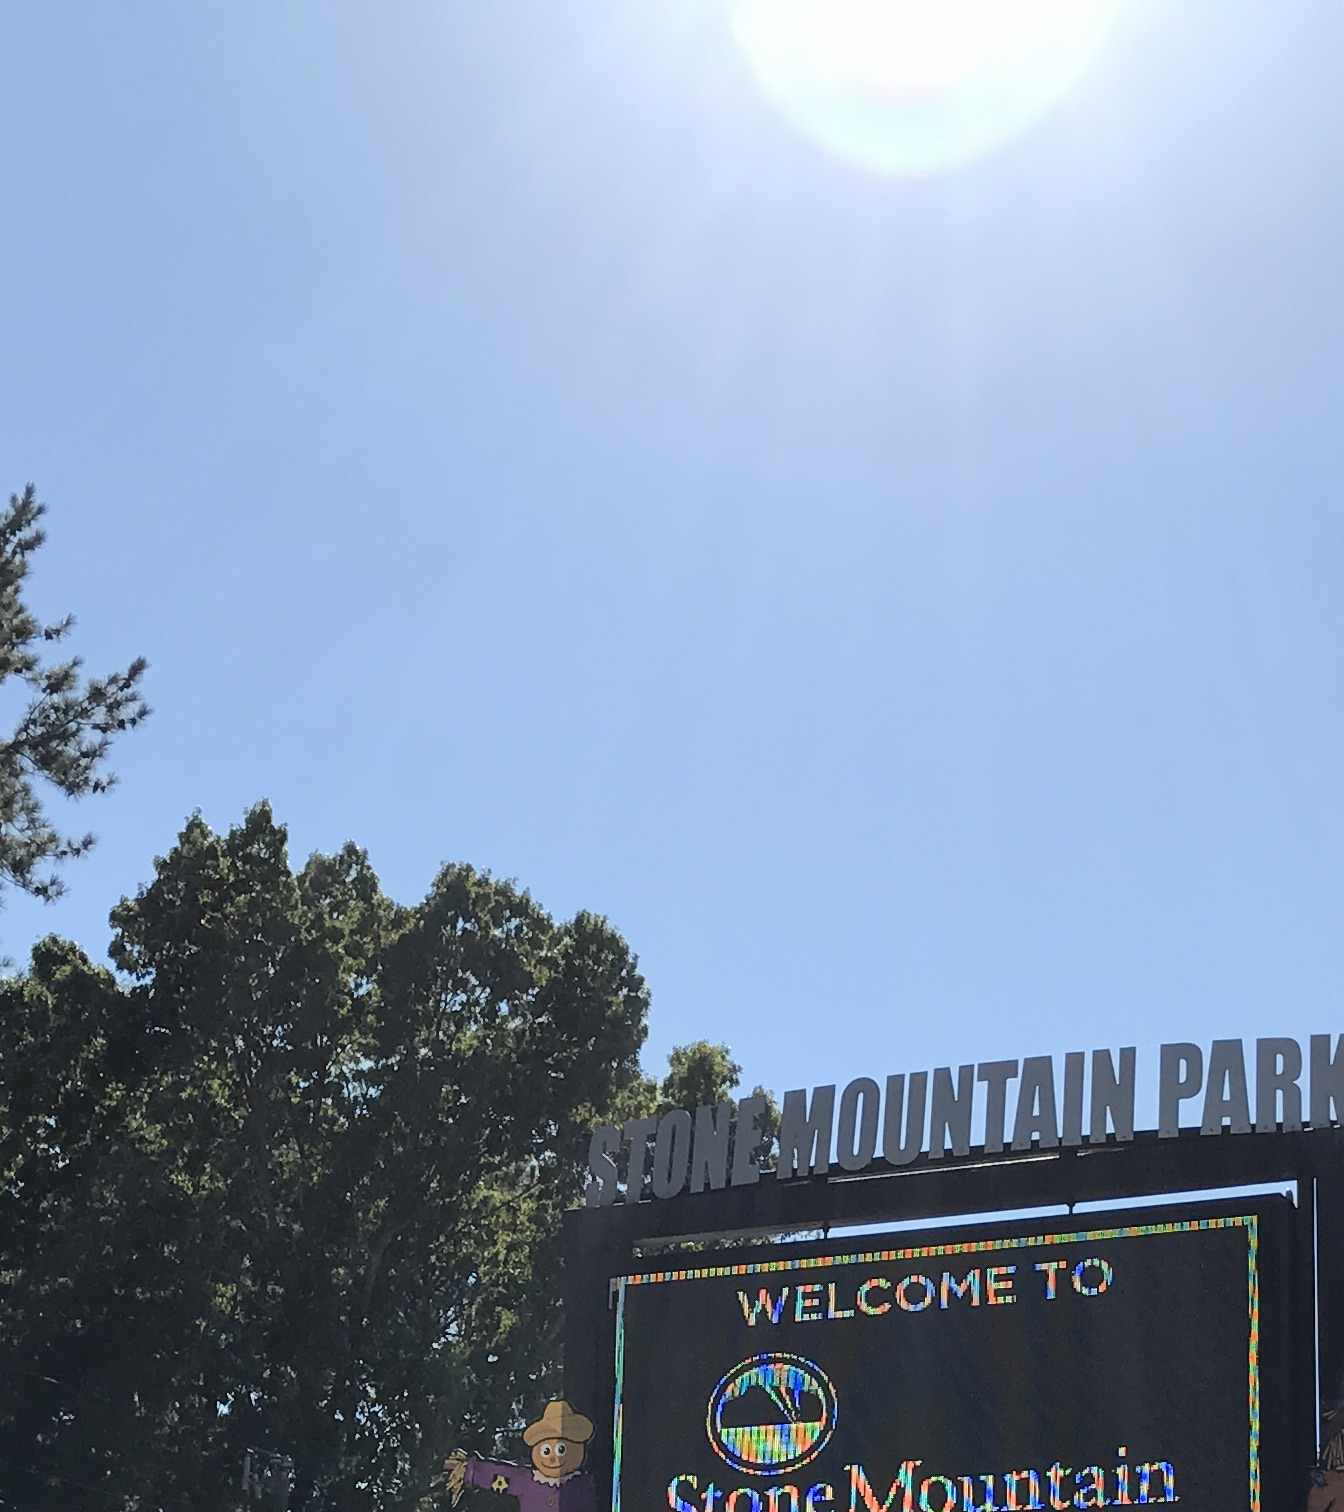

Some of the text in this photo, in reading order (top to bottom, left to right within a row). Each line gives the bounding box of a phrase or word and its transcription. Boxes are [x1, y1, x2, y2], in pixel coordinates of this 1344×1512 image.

[586, 1096, 765, 1208] STONE
[776, 1046, 1136, 1179] MOUNTAIN
[737, 1257, 1114, 1327] WELCOME TO
